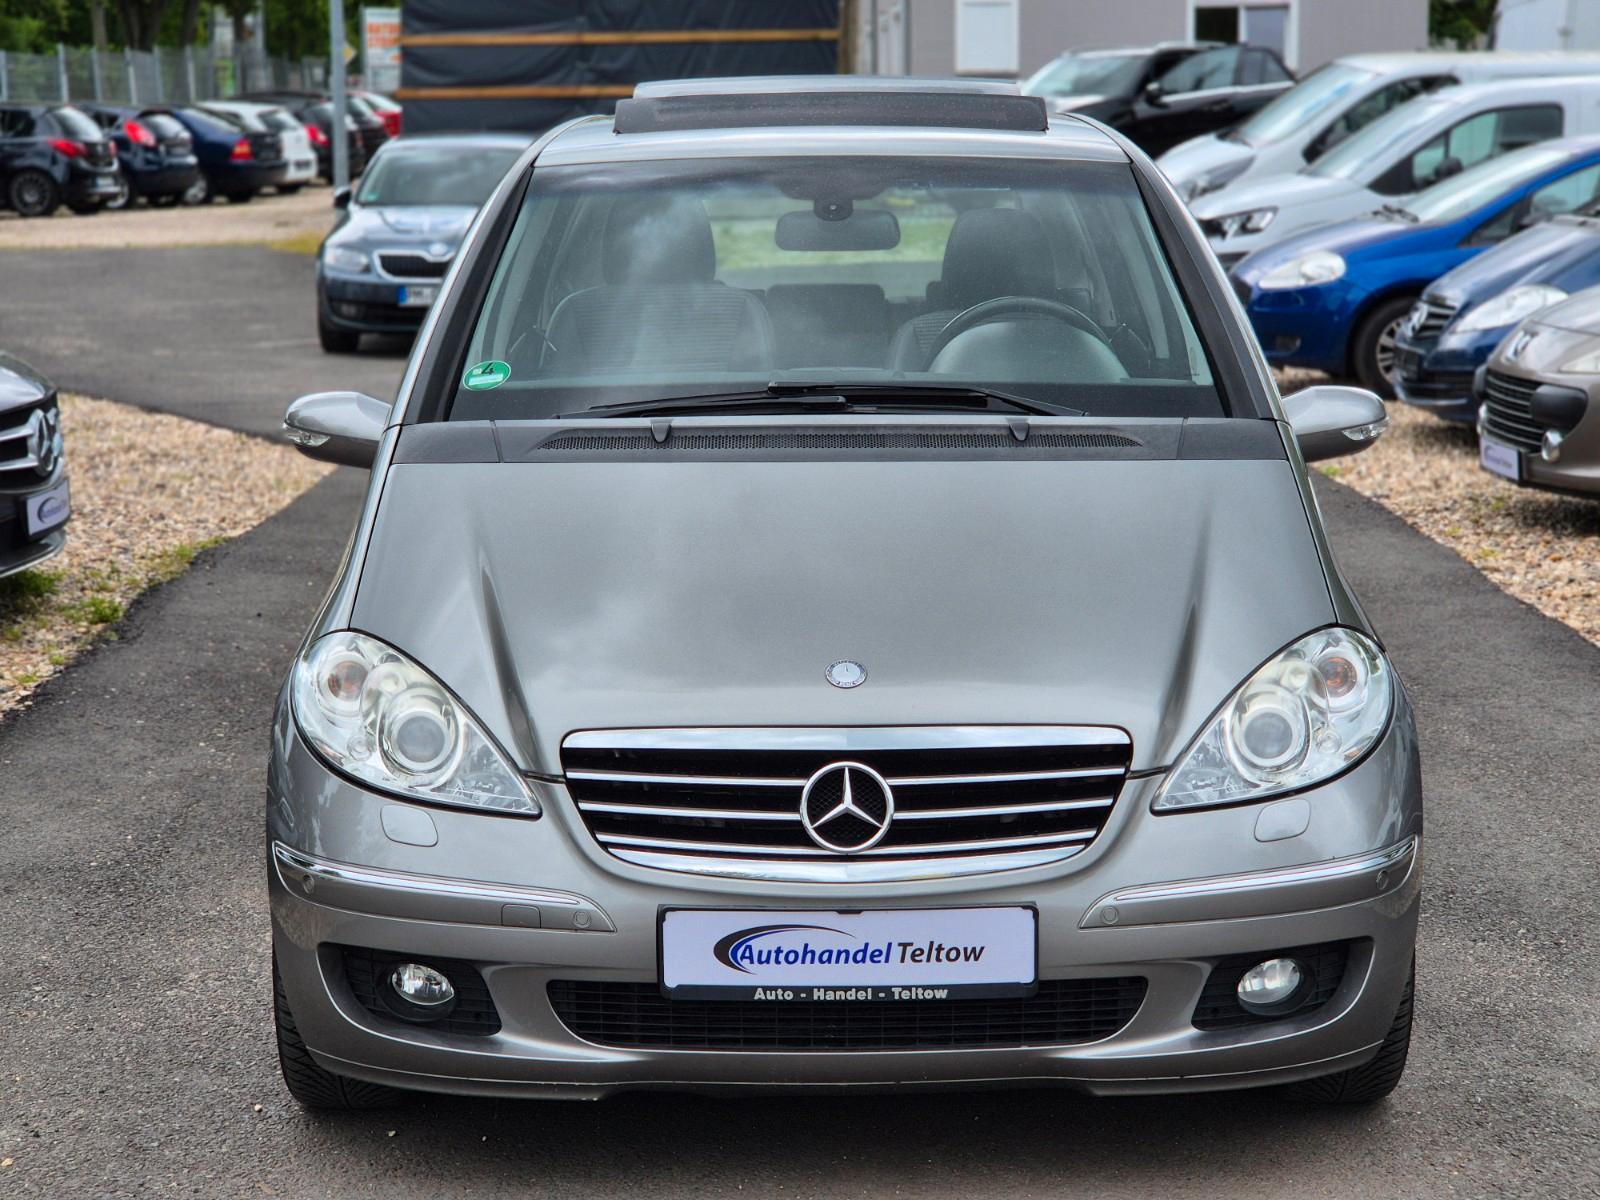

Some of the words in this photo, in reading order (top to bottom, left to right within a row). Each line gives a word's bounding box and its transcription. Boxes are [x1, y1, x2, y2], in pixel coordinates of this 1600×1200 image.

[739, 942, 892, 965] Autohandel
[897, 941, 985, 963] Teltow
[754, 988, 794, 1000] Auto
[813, 987, 872, 1000] Handel
[892, 987, 948, 1000] Teltow
